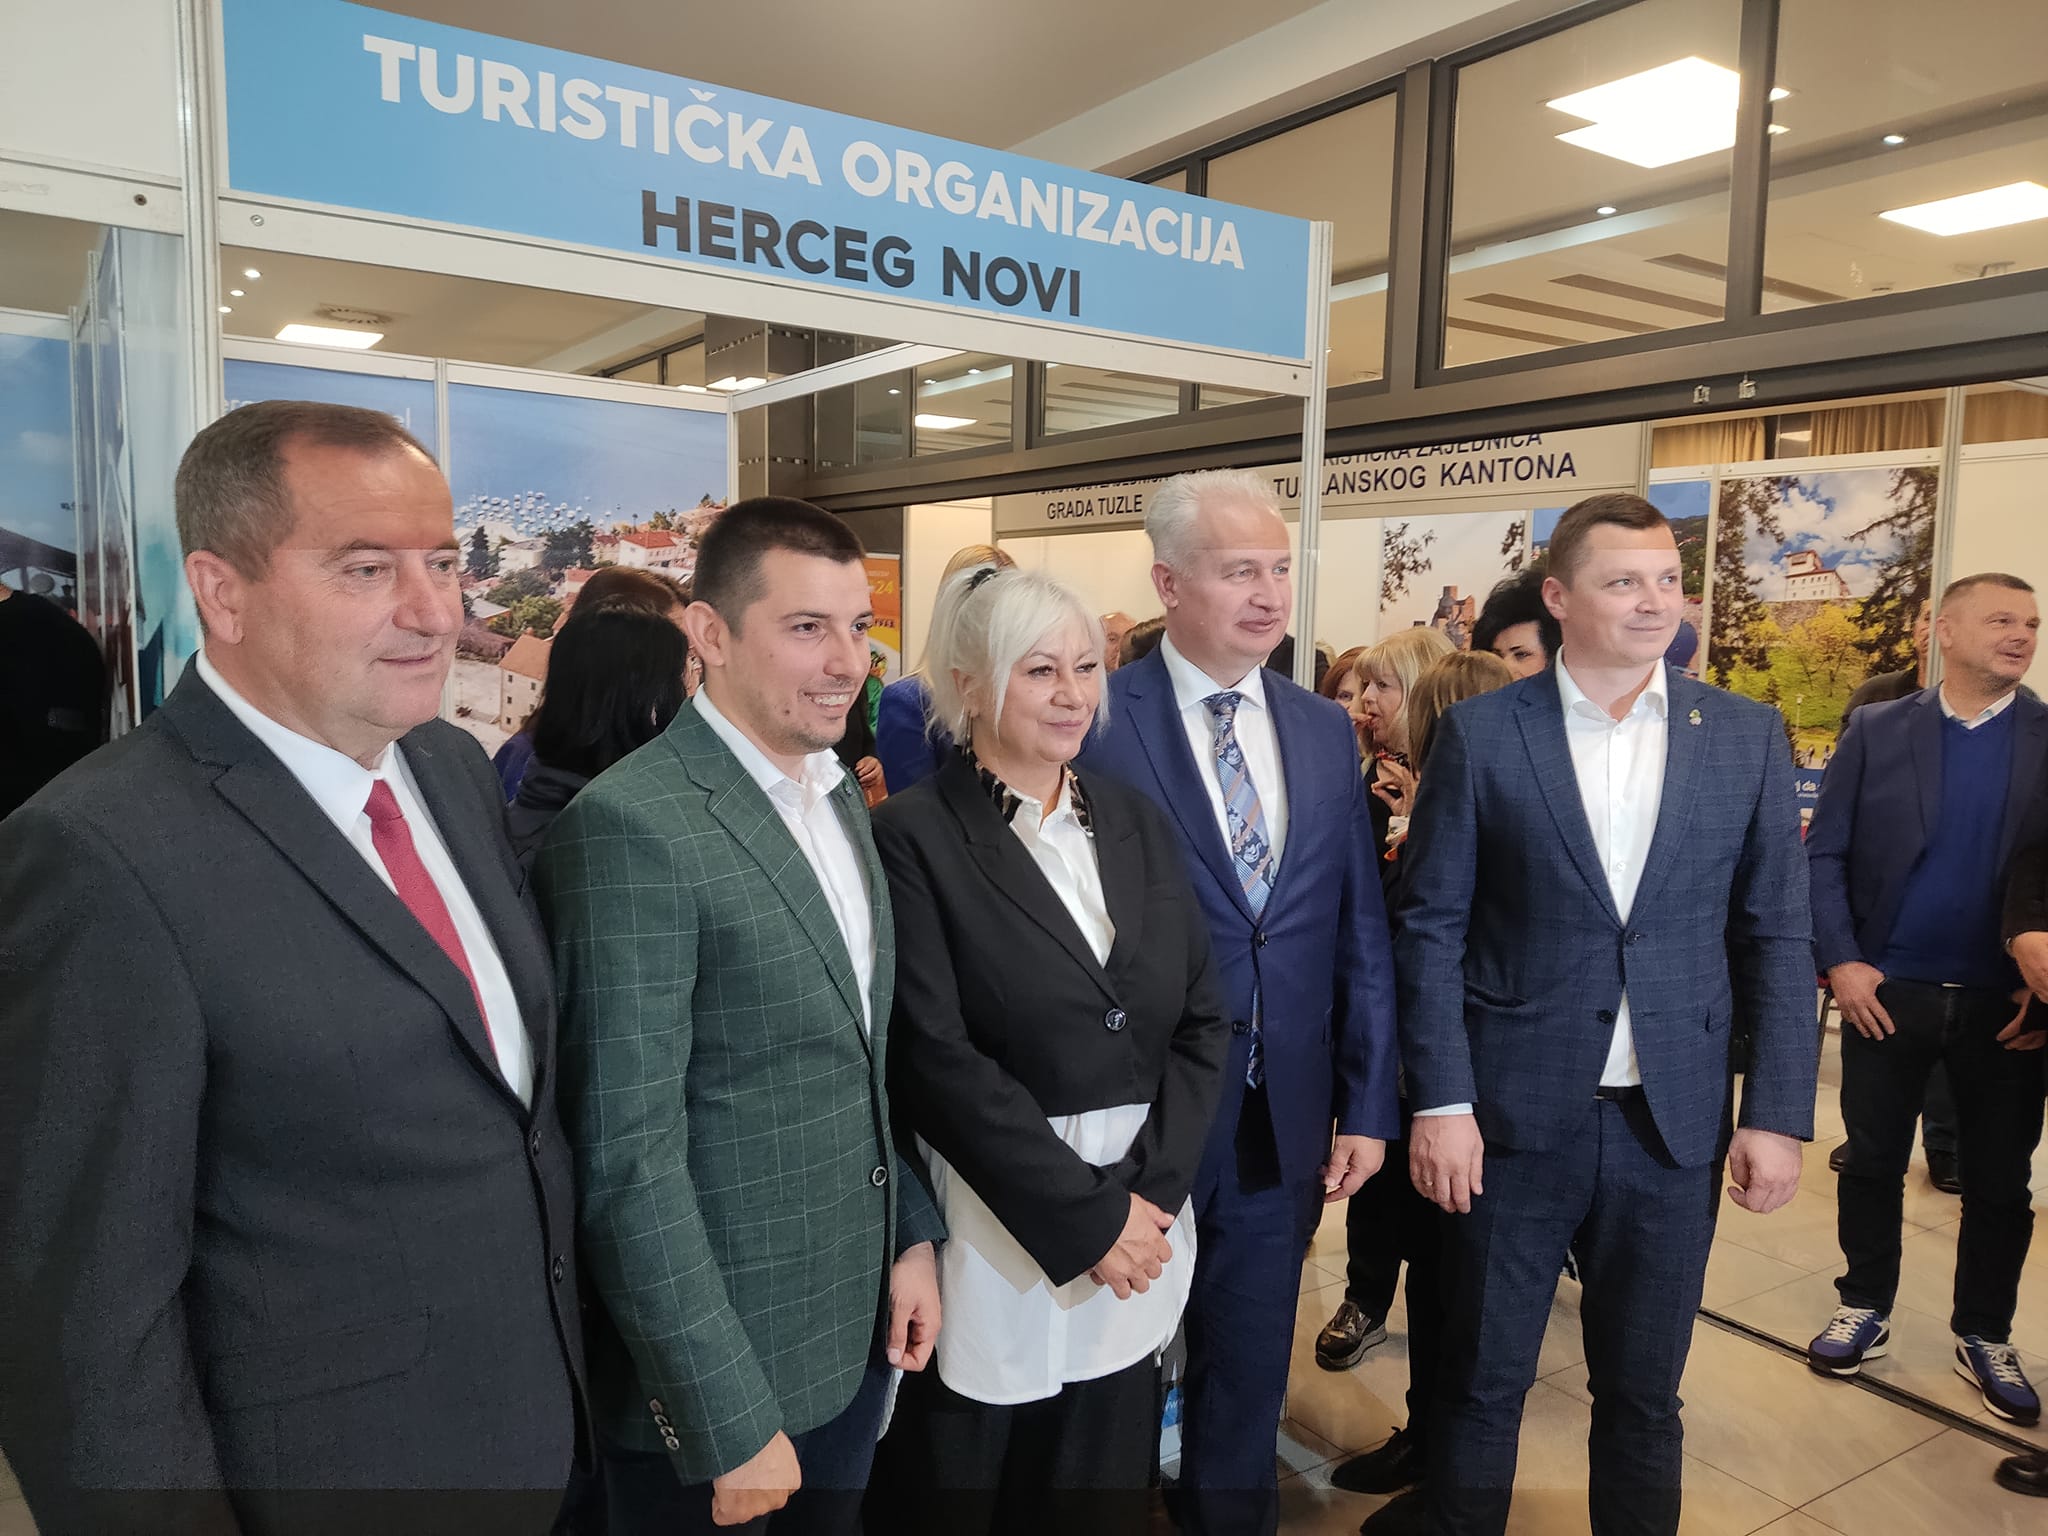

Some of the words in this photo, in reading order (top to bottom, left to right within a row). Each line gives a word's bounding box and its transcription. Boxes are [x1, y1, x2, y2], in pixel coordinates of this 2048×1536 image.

[362, 34, 822, 186] TURISTIČKA
[841, 141, 1245, 270] ORGANIZACIJA
[641, 190, 914, 288] HERCEG
[942, 246, 1080, 317] NOVI
[1047, 499, 1094, 519] GRADA
[1098, 494, 1143, 515] TUZLE
[1273, 465, 1426, 498] TUANSKOG
[1440, 452, 1576, 487] KANTONA
